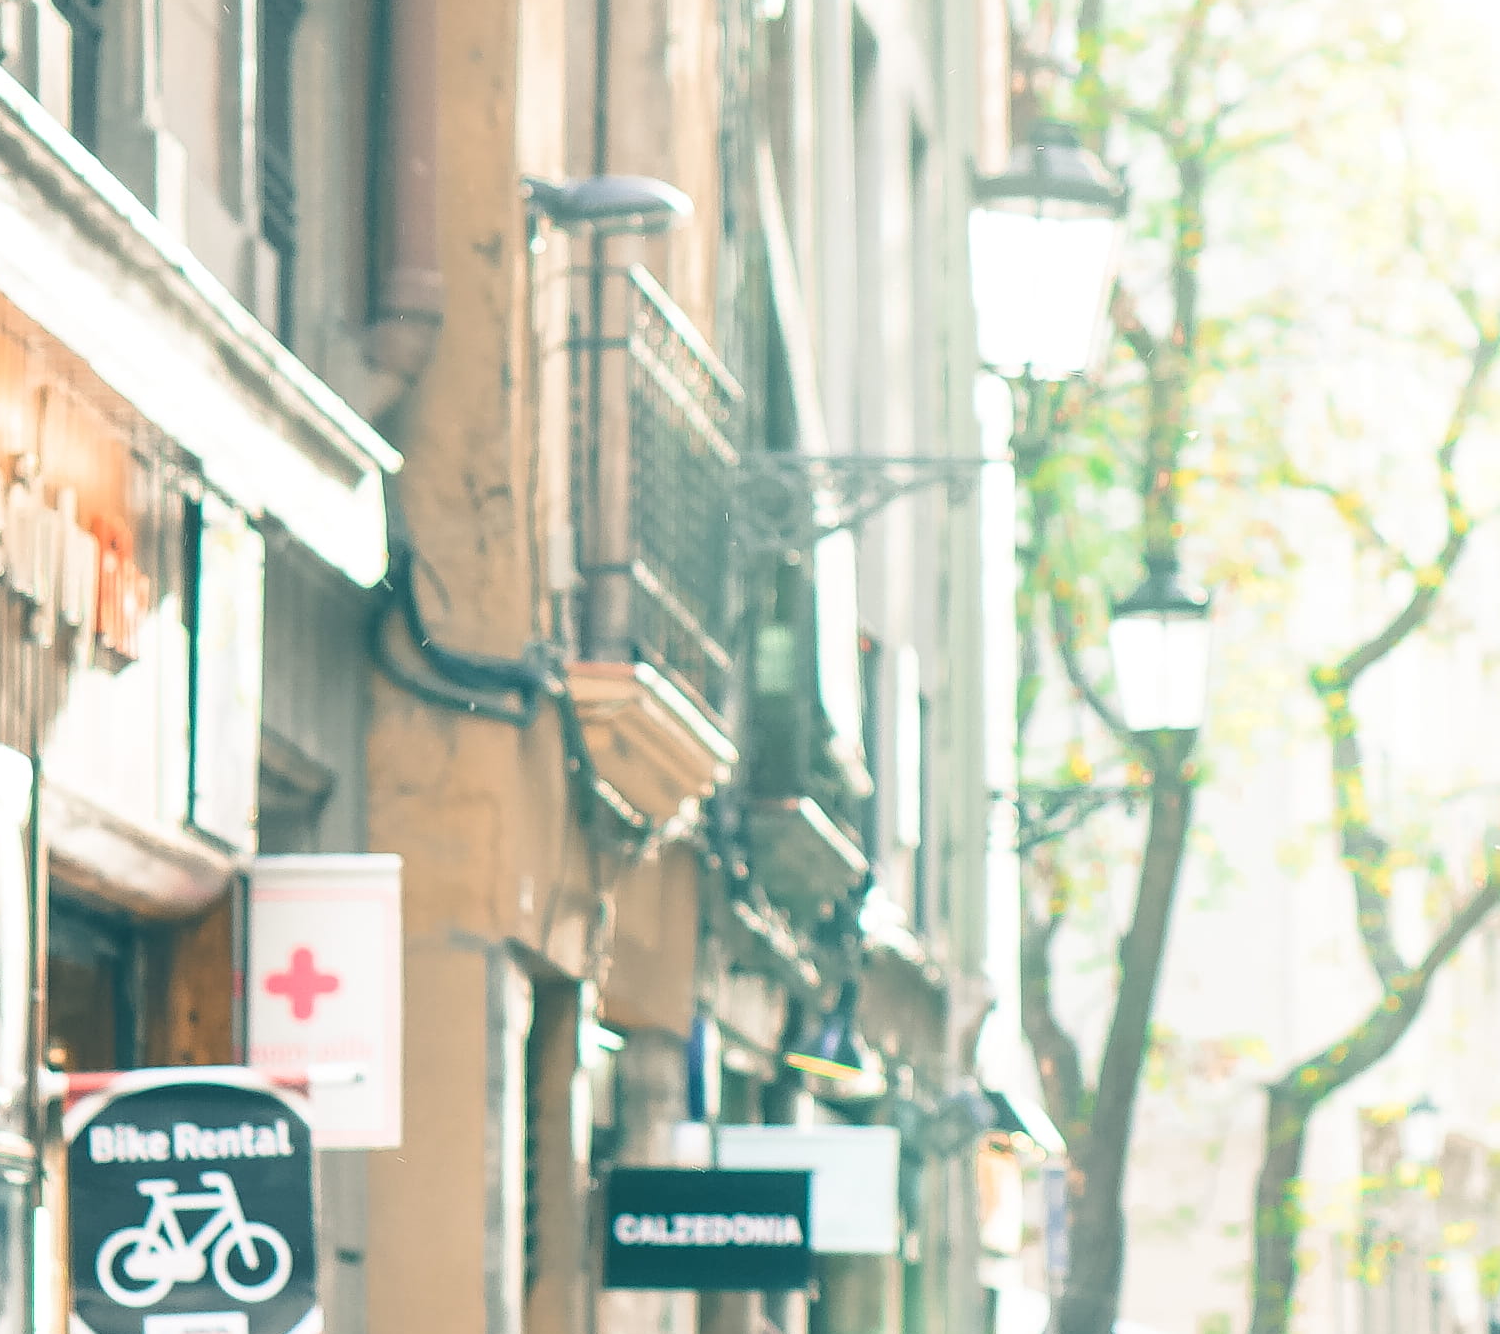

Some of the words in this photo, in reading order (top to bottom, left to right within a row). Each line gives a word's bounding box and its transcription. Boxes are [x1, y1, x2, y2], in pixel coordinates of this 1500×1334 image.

[90, 1124, 171, 1164] Bike
[172, 1119, 294, 1161] Rental
[614, 1212, 803, 1245] CALZEDONIA
